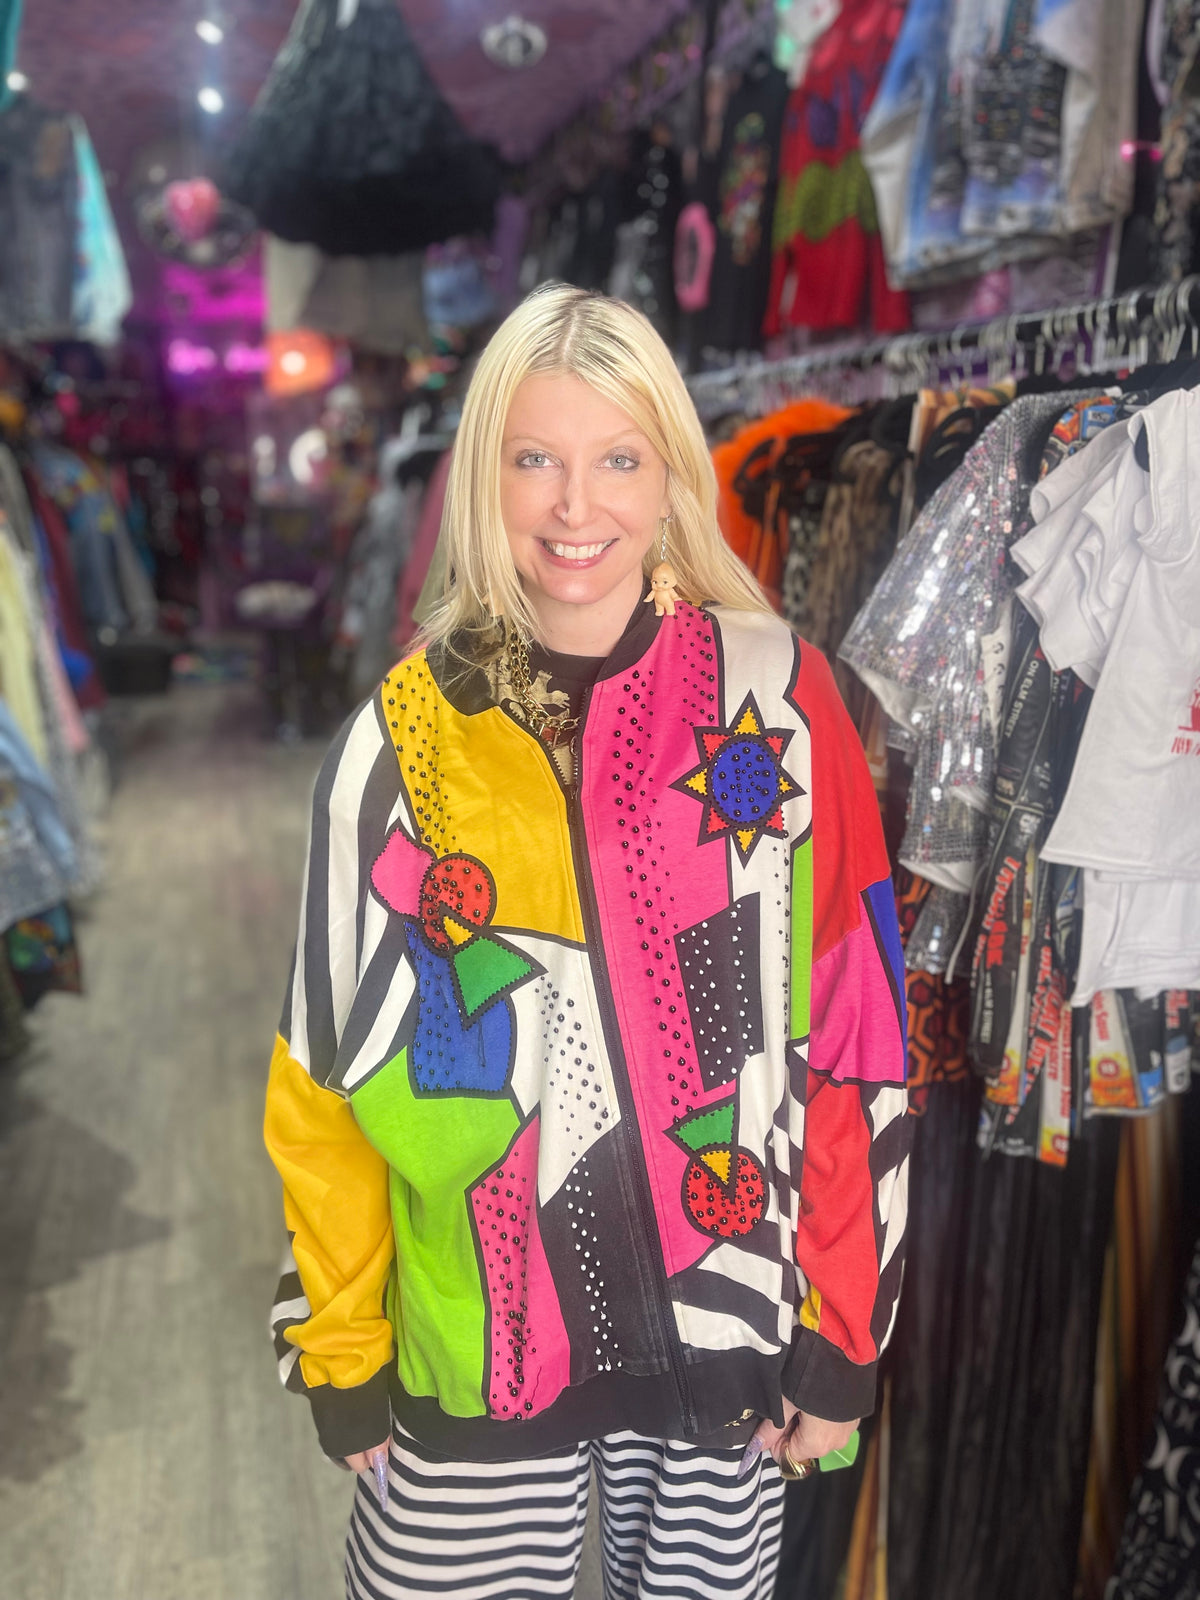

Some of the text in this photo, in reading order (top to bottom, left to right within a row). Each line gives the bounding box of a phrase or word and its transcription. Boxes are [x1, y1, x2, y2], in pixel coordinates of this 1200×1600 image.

[1004, 660, 1039, 738] ON ELM STREET
